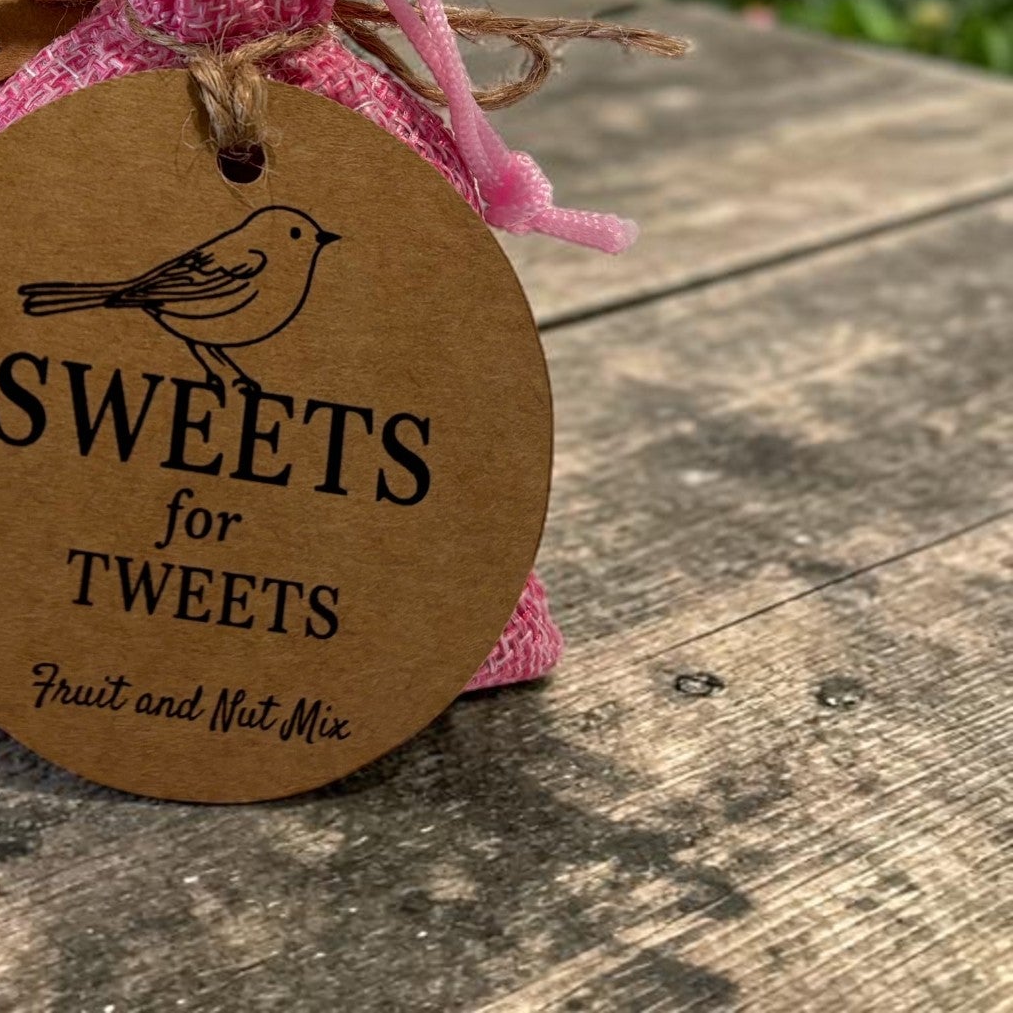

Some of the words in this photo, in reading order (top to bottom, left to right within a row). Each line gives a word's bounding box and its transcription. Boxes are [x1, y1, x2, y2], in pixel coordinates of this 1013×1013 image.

[155, 488, 242, 549] for
[67, 549, 340, 640] TWEETS
[31, 662, 132, 708] Fruit
[135, 685, 205, 721] and
[209, 688, 278, 732] Nut
[280, 696, 352, 744] Mix
